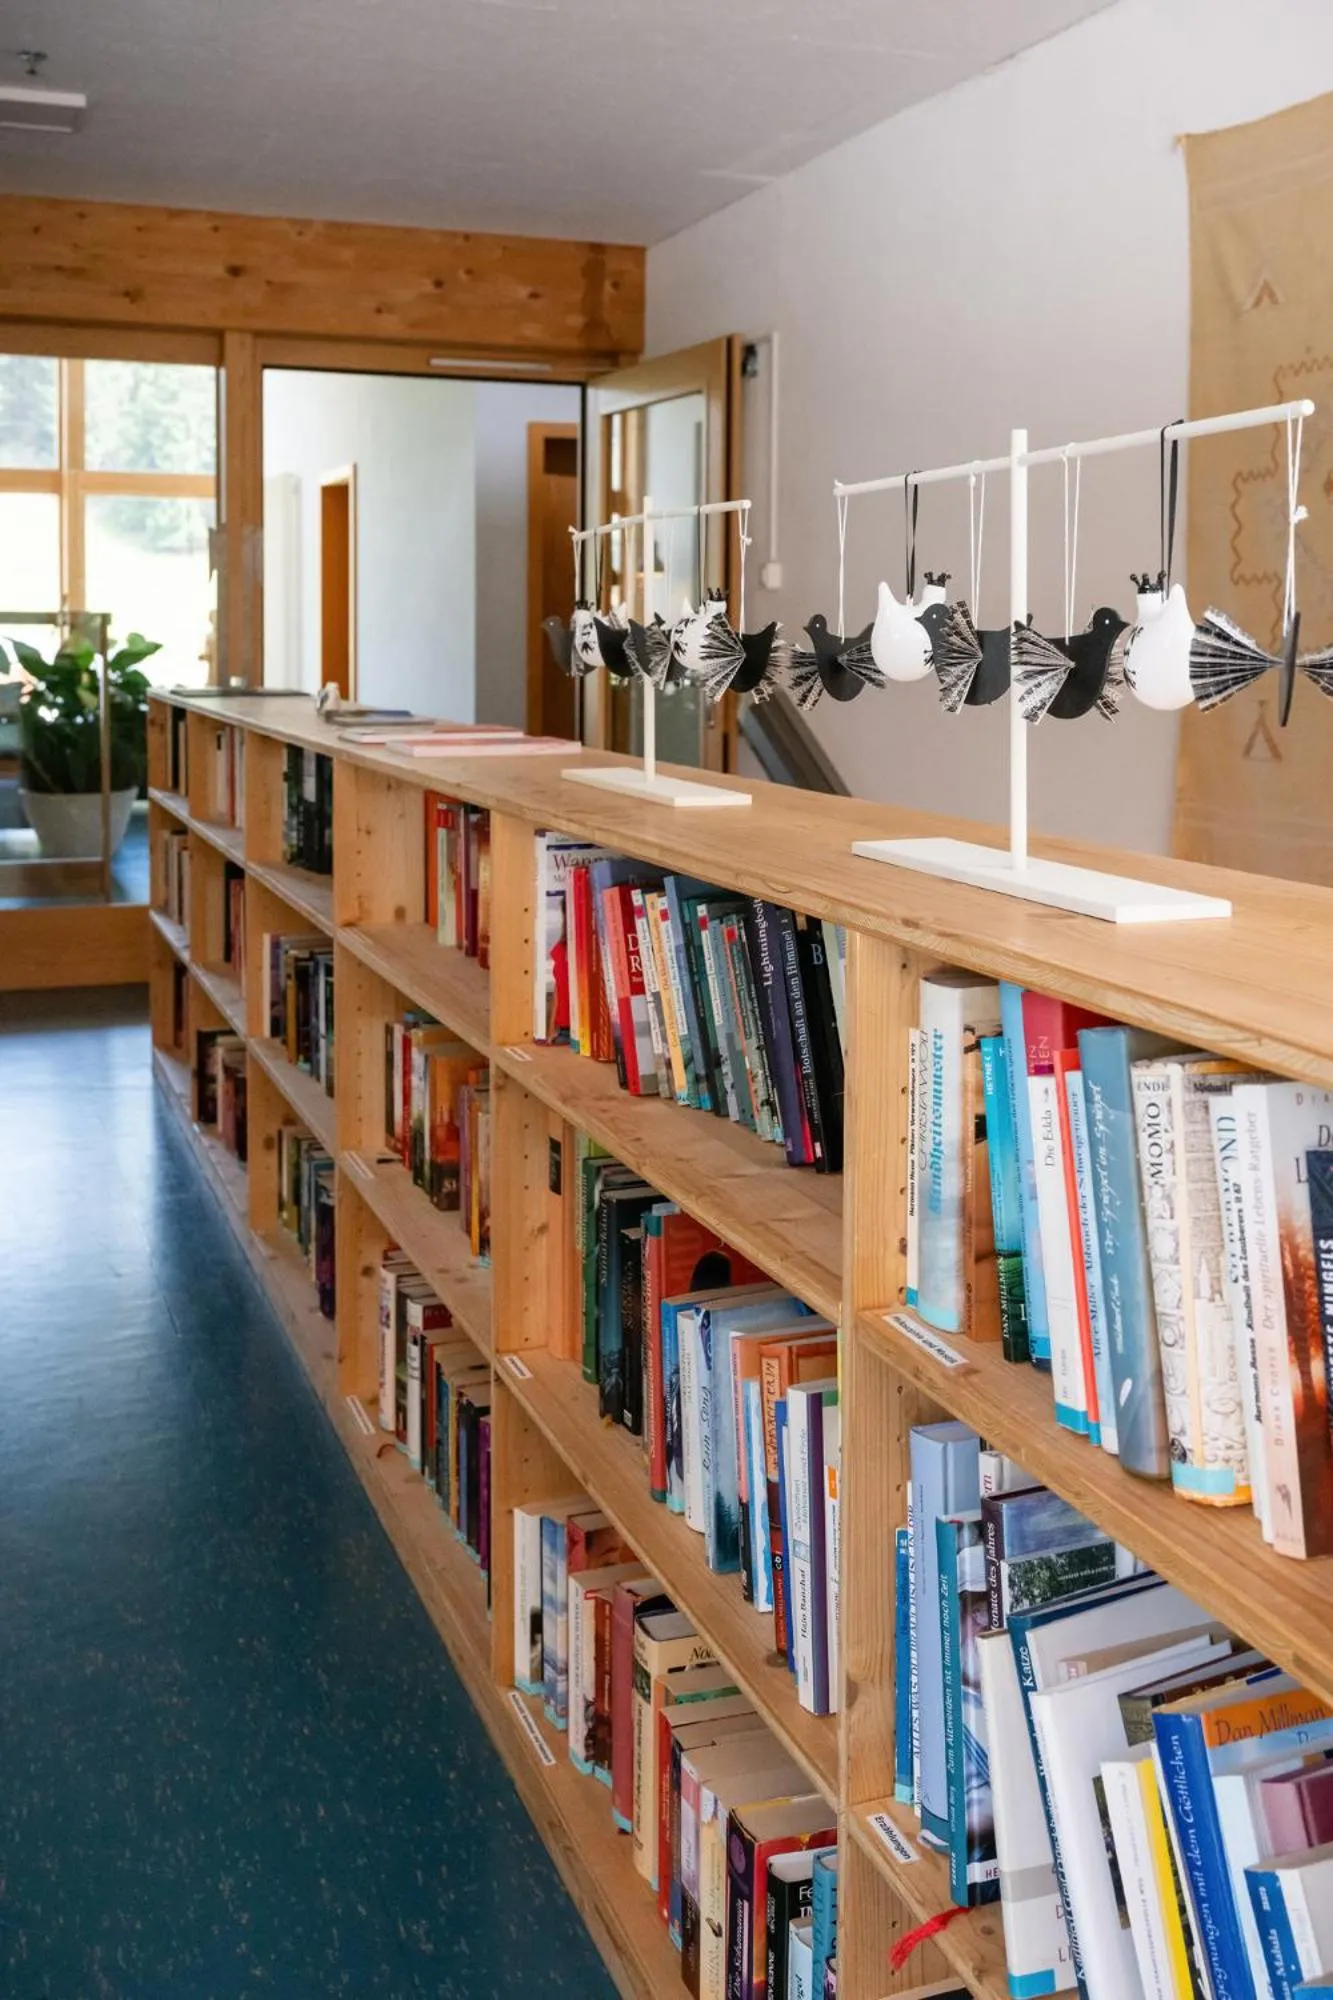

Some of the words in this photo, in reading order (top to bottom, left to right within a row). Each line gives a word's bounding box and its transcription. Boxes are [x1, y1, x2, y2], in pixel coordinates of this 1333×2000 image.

[782, 929, 798, 976] Himmel
[789, 977, 801, 999] den
[792, 1000, 804, 1016] an
[794, 1018, 813, 1075] Botschaft
[985, 1061, 995, 1096] HEYNE
[1136, 1080, 1170, 1093] ENDE
[1041, 1109, 1054, 1141] Edda
[1145, 1102, 1164, 1180] MOMO
[1044, 1144, 1056, 1167] Die
[1245, 1110, 1265, 1227] Lebens-Ratgeber
[1079, 1194, 1089, 1215] der
[1232, 1182, 1242, 1195] 67
[1082, 1218, 1094, 1273] Abbruch
[1236, 1208, 1248, 1261] Zauberers
[1241, 1264, 1250, 1282] des
[1254, 1229, 1274, 1299] spirituelle
[997, 1256, 1009, 1311] MILLMAN
[1089, 1281, 1098, 1322] Miller
[1001, 1312, 1010, 1339] DAN
[1243, 1285, 1255, 1332] Kindheit
[1261, 1304, 1275, 1331] Der
[1092, 1324, 1102, 1361] Alice
[1248, 1338, 1258, 1371] Hesse
[698, 1385, 713, 1428] Song
[1252, 1373, 1263, 1424] Hermann
[700, 1434, 712, 1473] Rain
[985, 1521, 1000, 1566] Jahres
[939, 1573, 949, 1598] Zeit
[987, 1565, 997, 1588] des
[940, 1600, 950, 1628] noch
[942, 1631, 952, 1666] immer
[1018, 1645, 1035, 1688] Katze
[944, 1670, 953, 1685] ist
[1213, 1717, 1254, 1747] Dan
[1257, 1702, 1327, 1741] Millman
[946, 1749, 956, 1774] Zum
[1167, 1734, 1195, 1823] Göttlichen
[1186, 1827, 1202, 1865] dem
[1194, 1870, 1207, 1897] mit
